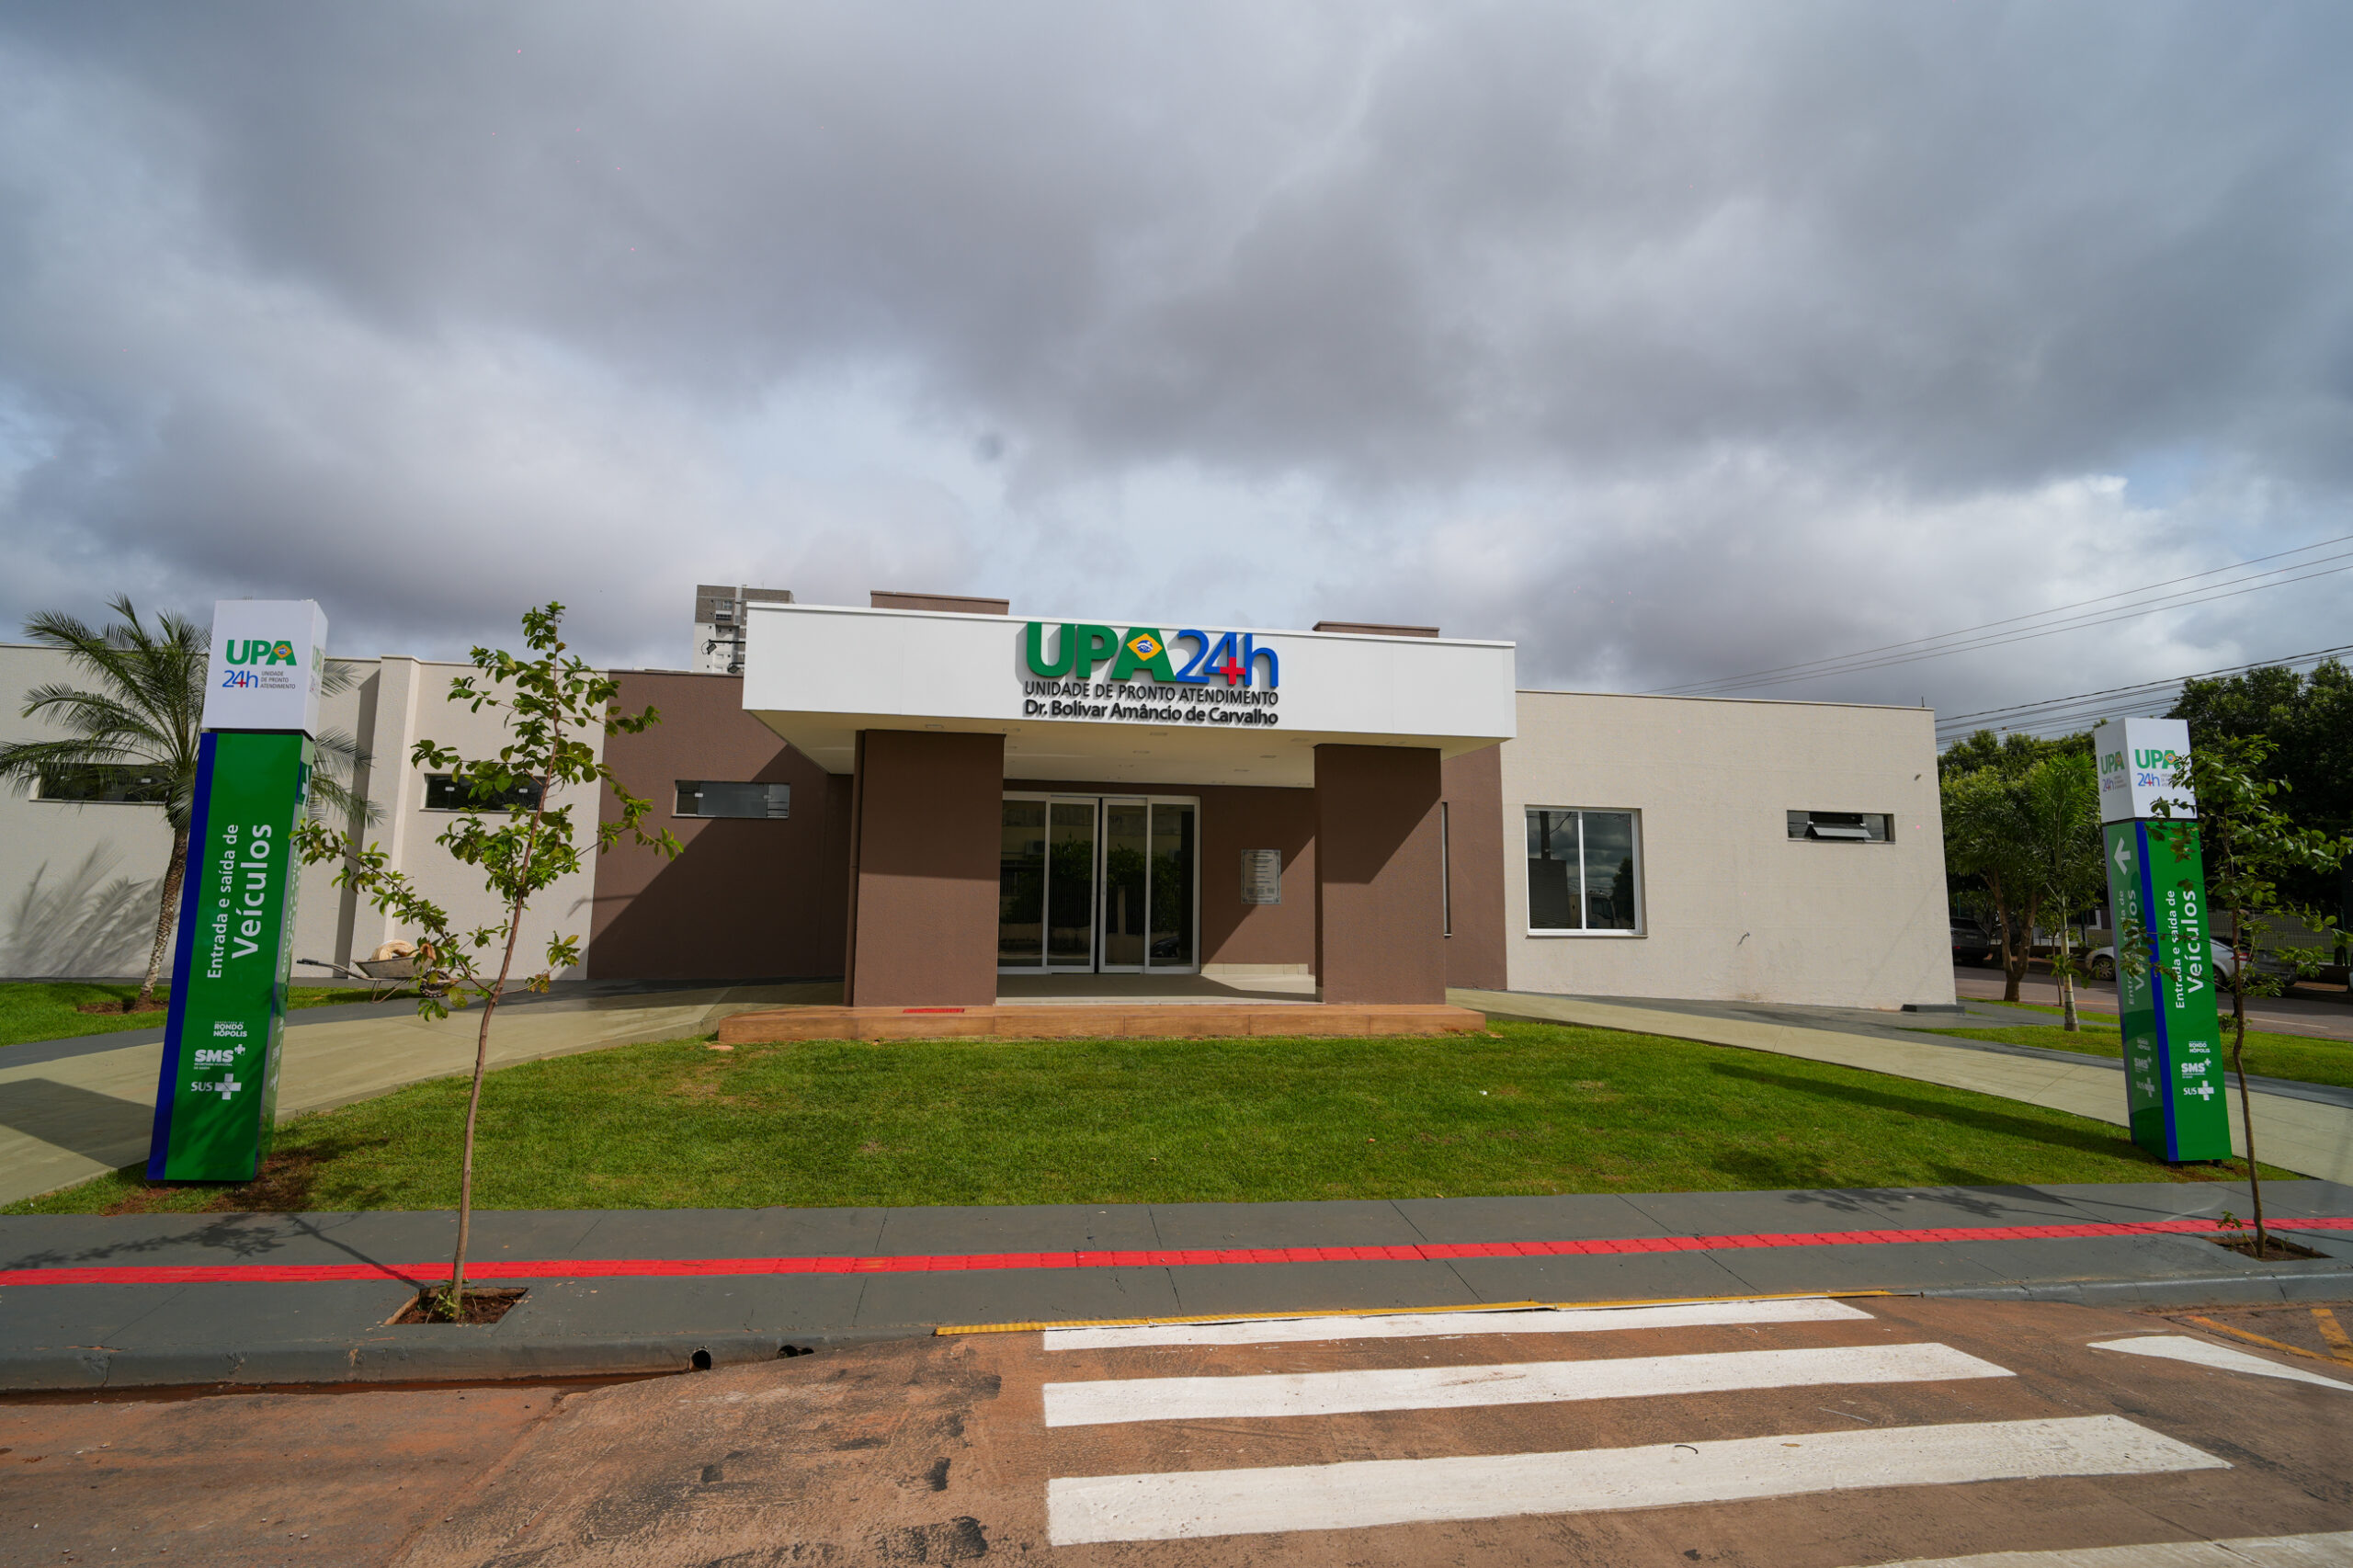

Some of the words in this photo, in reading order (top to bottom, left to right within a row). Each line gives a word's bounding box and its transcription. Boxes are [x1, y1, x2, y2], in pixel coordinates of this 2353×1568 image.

[225, 639, 297, 666] UPA
[1026, 621, 1176, 682] UPA
[1175, 629, 1279, 687] 24h
[222, 669, 258, 688] 24h
[1025, 681, 1090, 698] UNIDADE
[1096, 683, 1113, 699] DE
[1119, 684, 1176, 701] PRONTO
[1179, 687, 1279, 706] ATENDIMENTO
[1025, 699, 1048, 715] Dr.
[1051, 699, 1108, 717] Bolivar
[1110, 702, 1182, 721] Amâncio
[1185, 706, 1206, 722] de
[1209, 707, 1279, 724] Carvalho
[2100, 751, 2125, 775] UPA
[2134, 749, 2181, 770] UPA
[2136, 772, 2161, 787] 24h
[222, 824, 239, 845] de
[219, 850, 236, 893] saída
[219, 898, 231, 908] e
[231, 824, 272, 960] Veículos
[2165, 890, 2176, 906] de
[2167, 910, 2178, 943] saída
[207, 913, 228, 978] Entrada
[2180, 890, 2204, 993] Veículos
[2171, 959, 2185, 1008] Entrada
[190, 1081, 213, 1092] SUS
[2183, 1086, 2197, 1096] SUS
